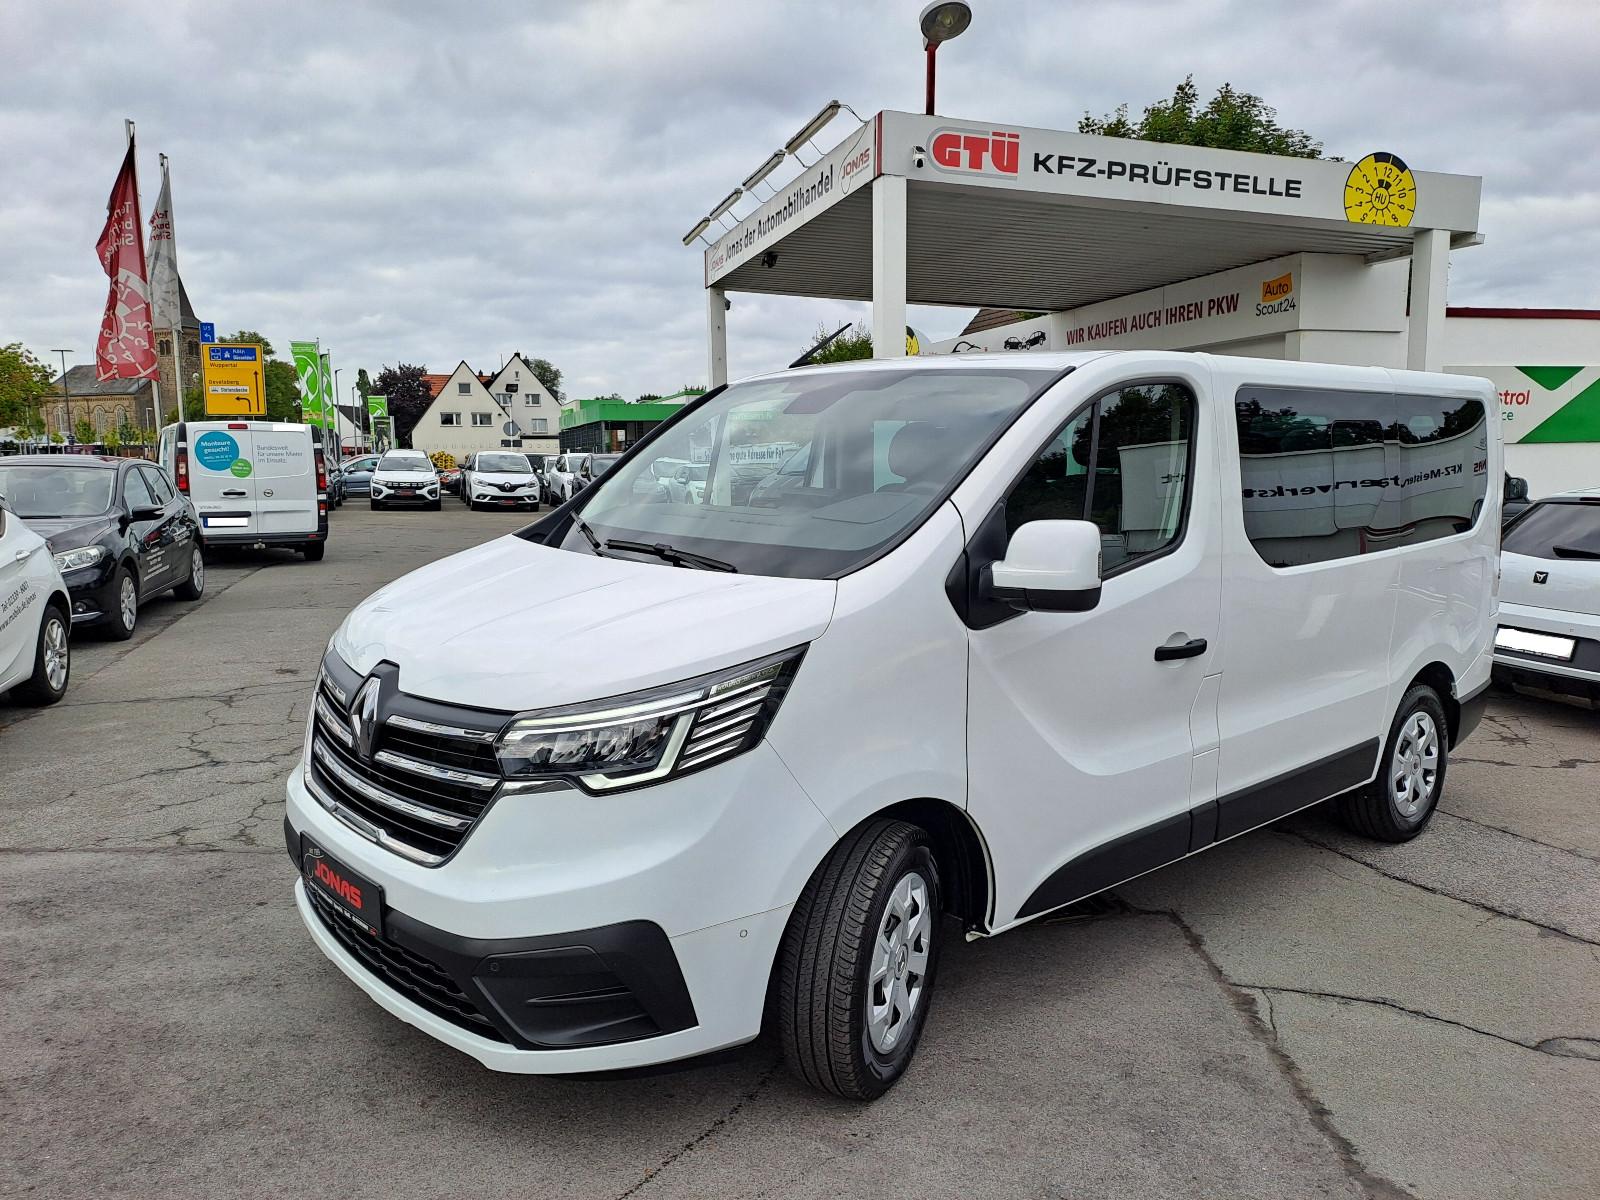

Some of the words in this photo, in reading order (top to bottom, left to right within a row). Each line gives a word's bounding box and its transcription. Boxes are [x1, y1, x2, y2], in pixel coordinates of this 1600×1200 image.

[932, 131, 1020, 174] GTÜ
[841, 148, 871, 180] JONAS
[1383, 166, 1393, 179] 12
[1033, 152, 1302, 198] KFZ-PRÜFSTELLE
[1392, 174, 1403, 187] 11
[1375, 192, 1386, 205] HU
[1397, 187, 1407, 199] 10
[725, 237, 743, 262] Jonas
[744, 227, 756, 249] der
[757, 163, 834, 241] Automobilhandel
[1263, 280, 1289, 297] Auto
[1255, 297, 1297, 317] Scout24
[1066, 326, 1085, 346] WIR
[1087, 317, 1128, 342] KAUFEN
[1130, 310, 1161, 333] AUCH
[1165, 300, 1203, 326] IHREN
[1207, 292, 1240, 317] PKW
[1498, 389, 1530, 406] strol
[314, 859, 363, 909] JONAS
